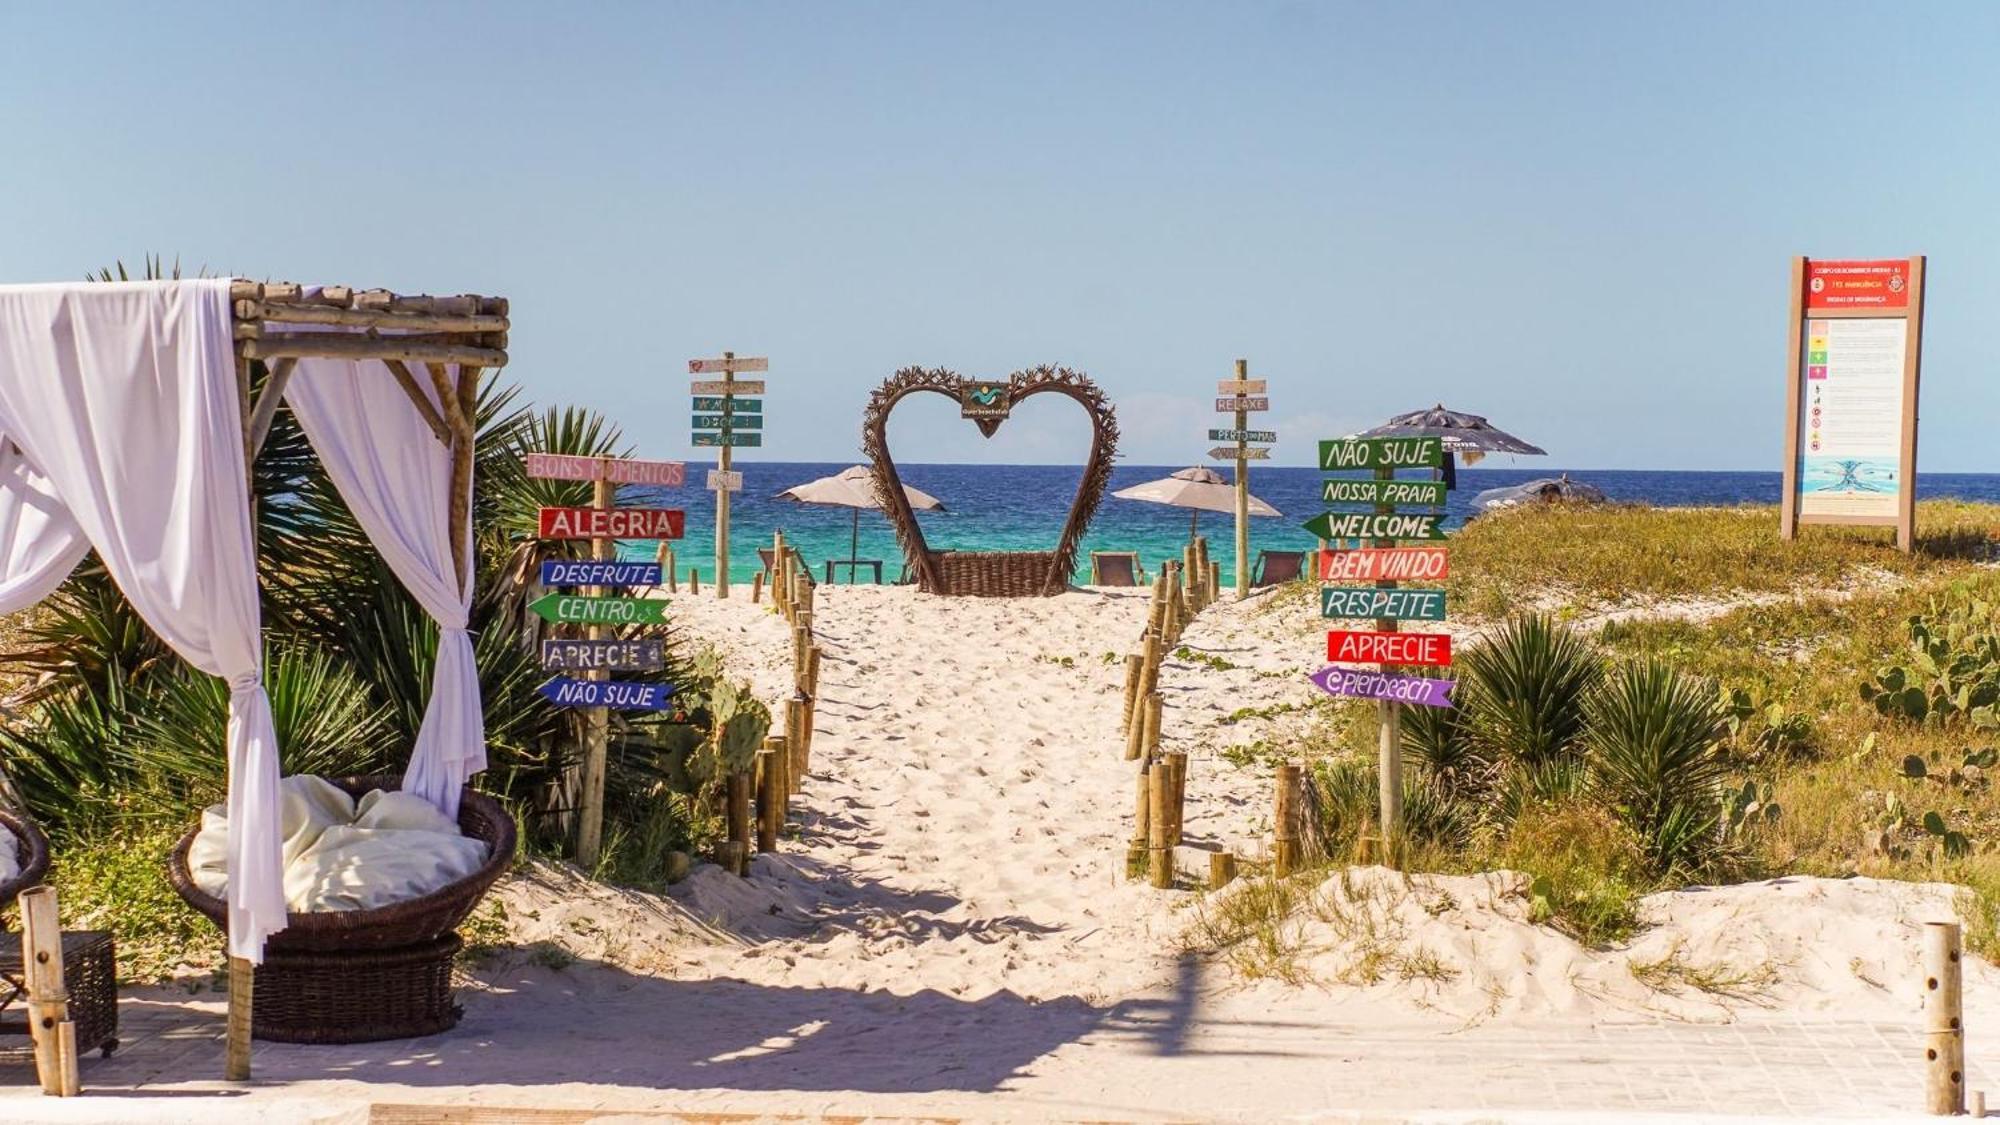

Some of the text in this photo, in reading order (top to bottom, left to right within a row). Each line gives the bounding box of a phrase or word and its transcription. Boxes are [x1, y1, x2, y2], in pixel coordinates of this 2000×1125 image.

[1217, 399, 1264, 411] RELAXE
[1326, 438, 1435, 467] NÃO SUJE
[533, 455, 584, 477] BONS
[592, 459, 683, 484] MOMENTOS
[1323, 482, 1437, 503] NOSSA PRAIA
[549, 510, 673, 538] ALEGRIA
[1328, 515, 1434, 538] WELCOME
[550, 563, 658, 584] DESFRUTE
[1328, 551, 1444, 579] BEM VINDO
[558, 598, 635, 621] CENTRO
[1325, 590, 1440, 617] RESPEITE
[547, 645, 641, 667] APRECIE
[1338, 634, 1438, 662] APRECIE
[556, 681, 656, 706] NÃO SUJE
